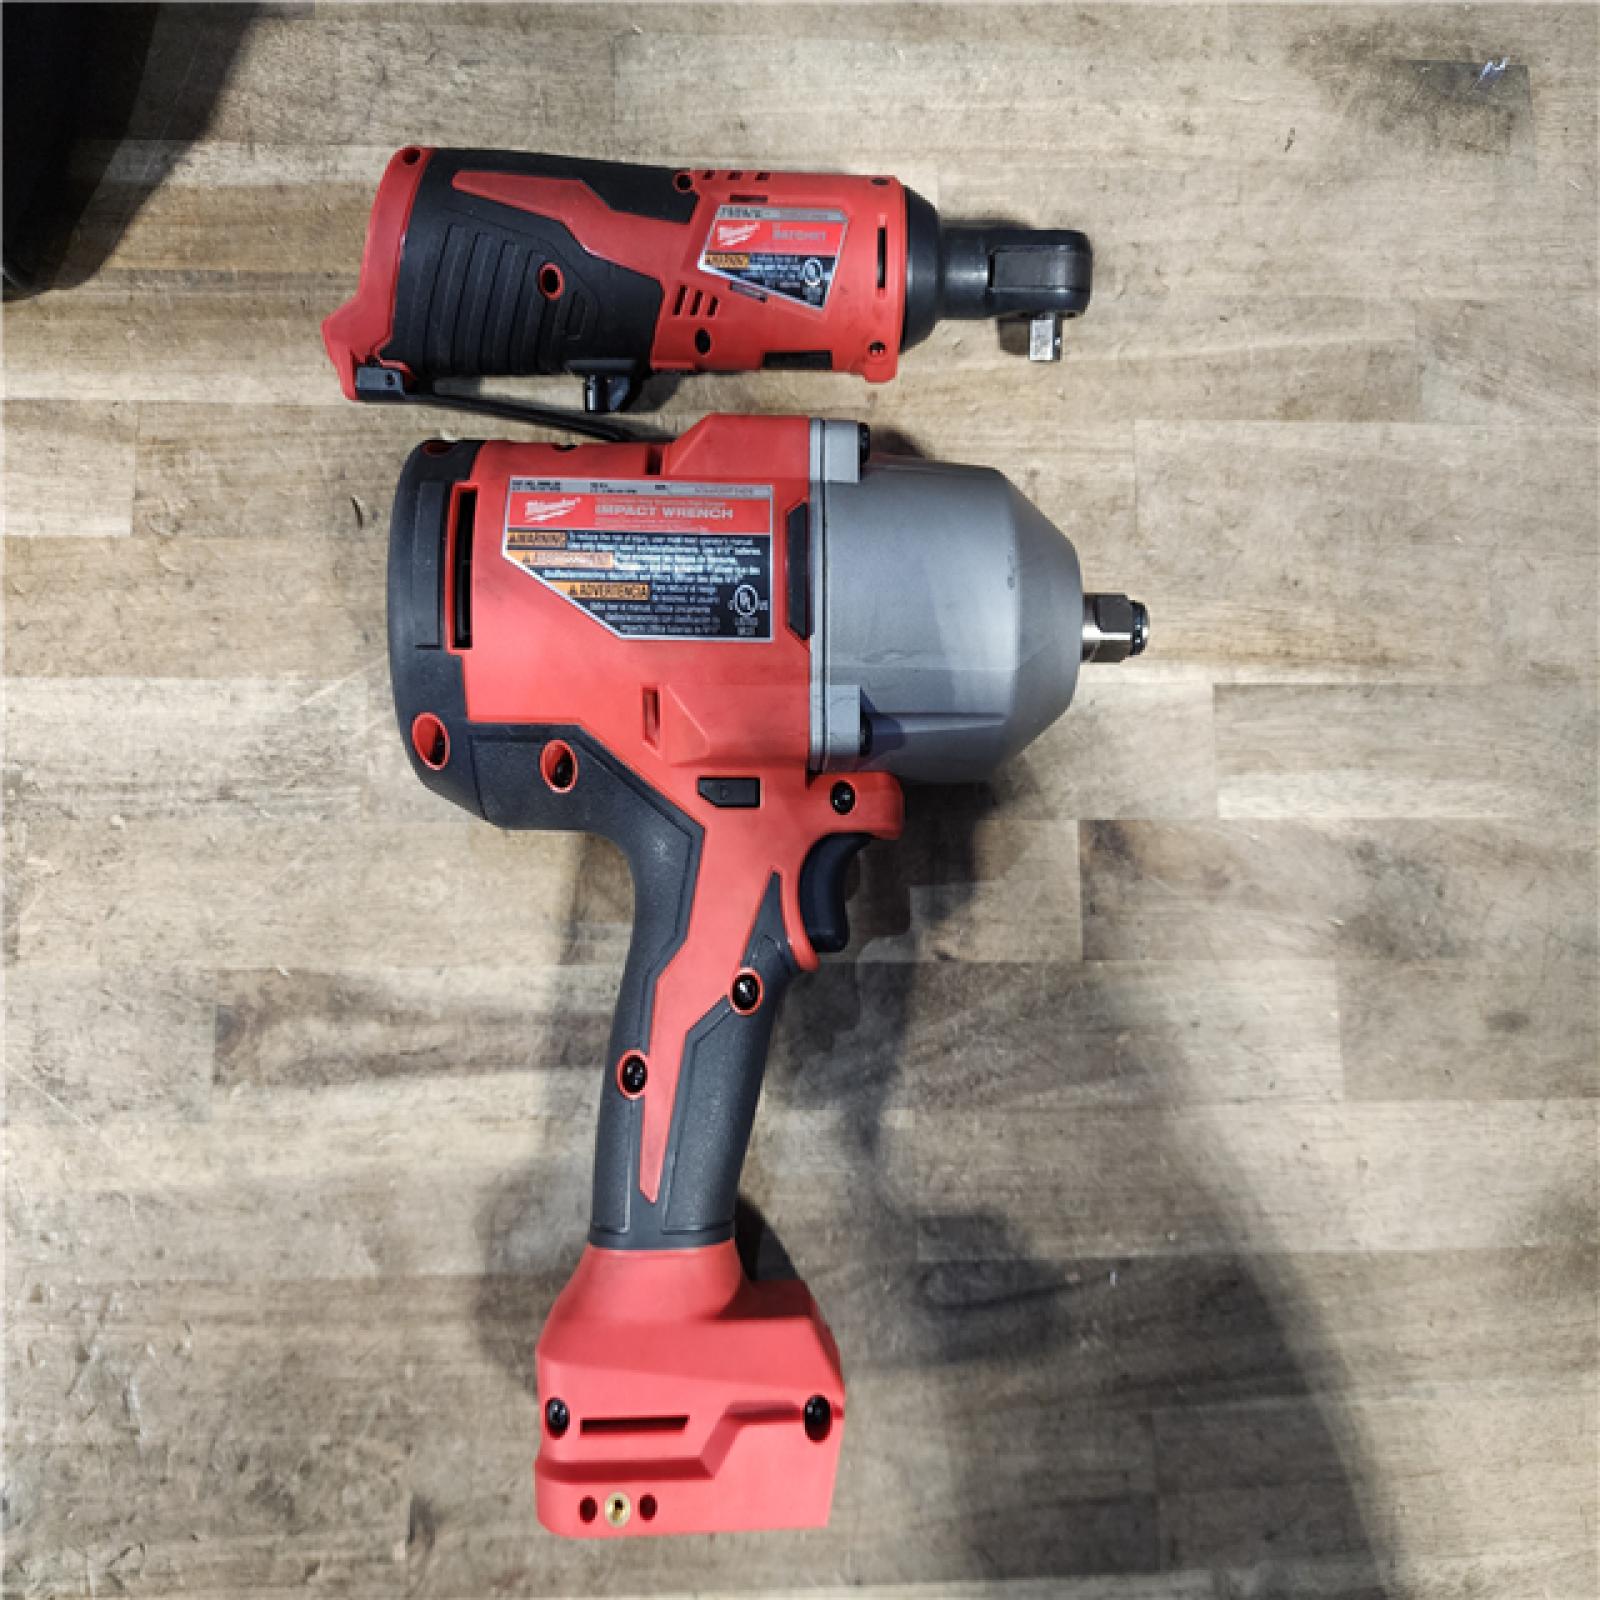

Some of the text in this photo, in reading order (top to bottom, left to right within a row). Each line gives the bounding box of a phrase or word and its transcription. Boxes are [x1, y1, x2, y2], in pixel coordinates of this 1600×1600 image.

[594, 503, 734, 520] IMPACT WRENCH
[519, 532, 565, 546] WARNING
[579, 583, 648, 599] ADVERTENCIA
